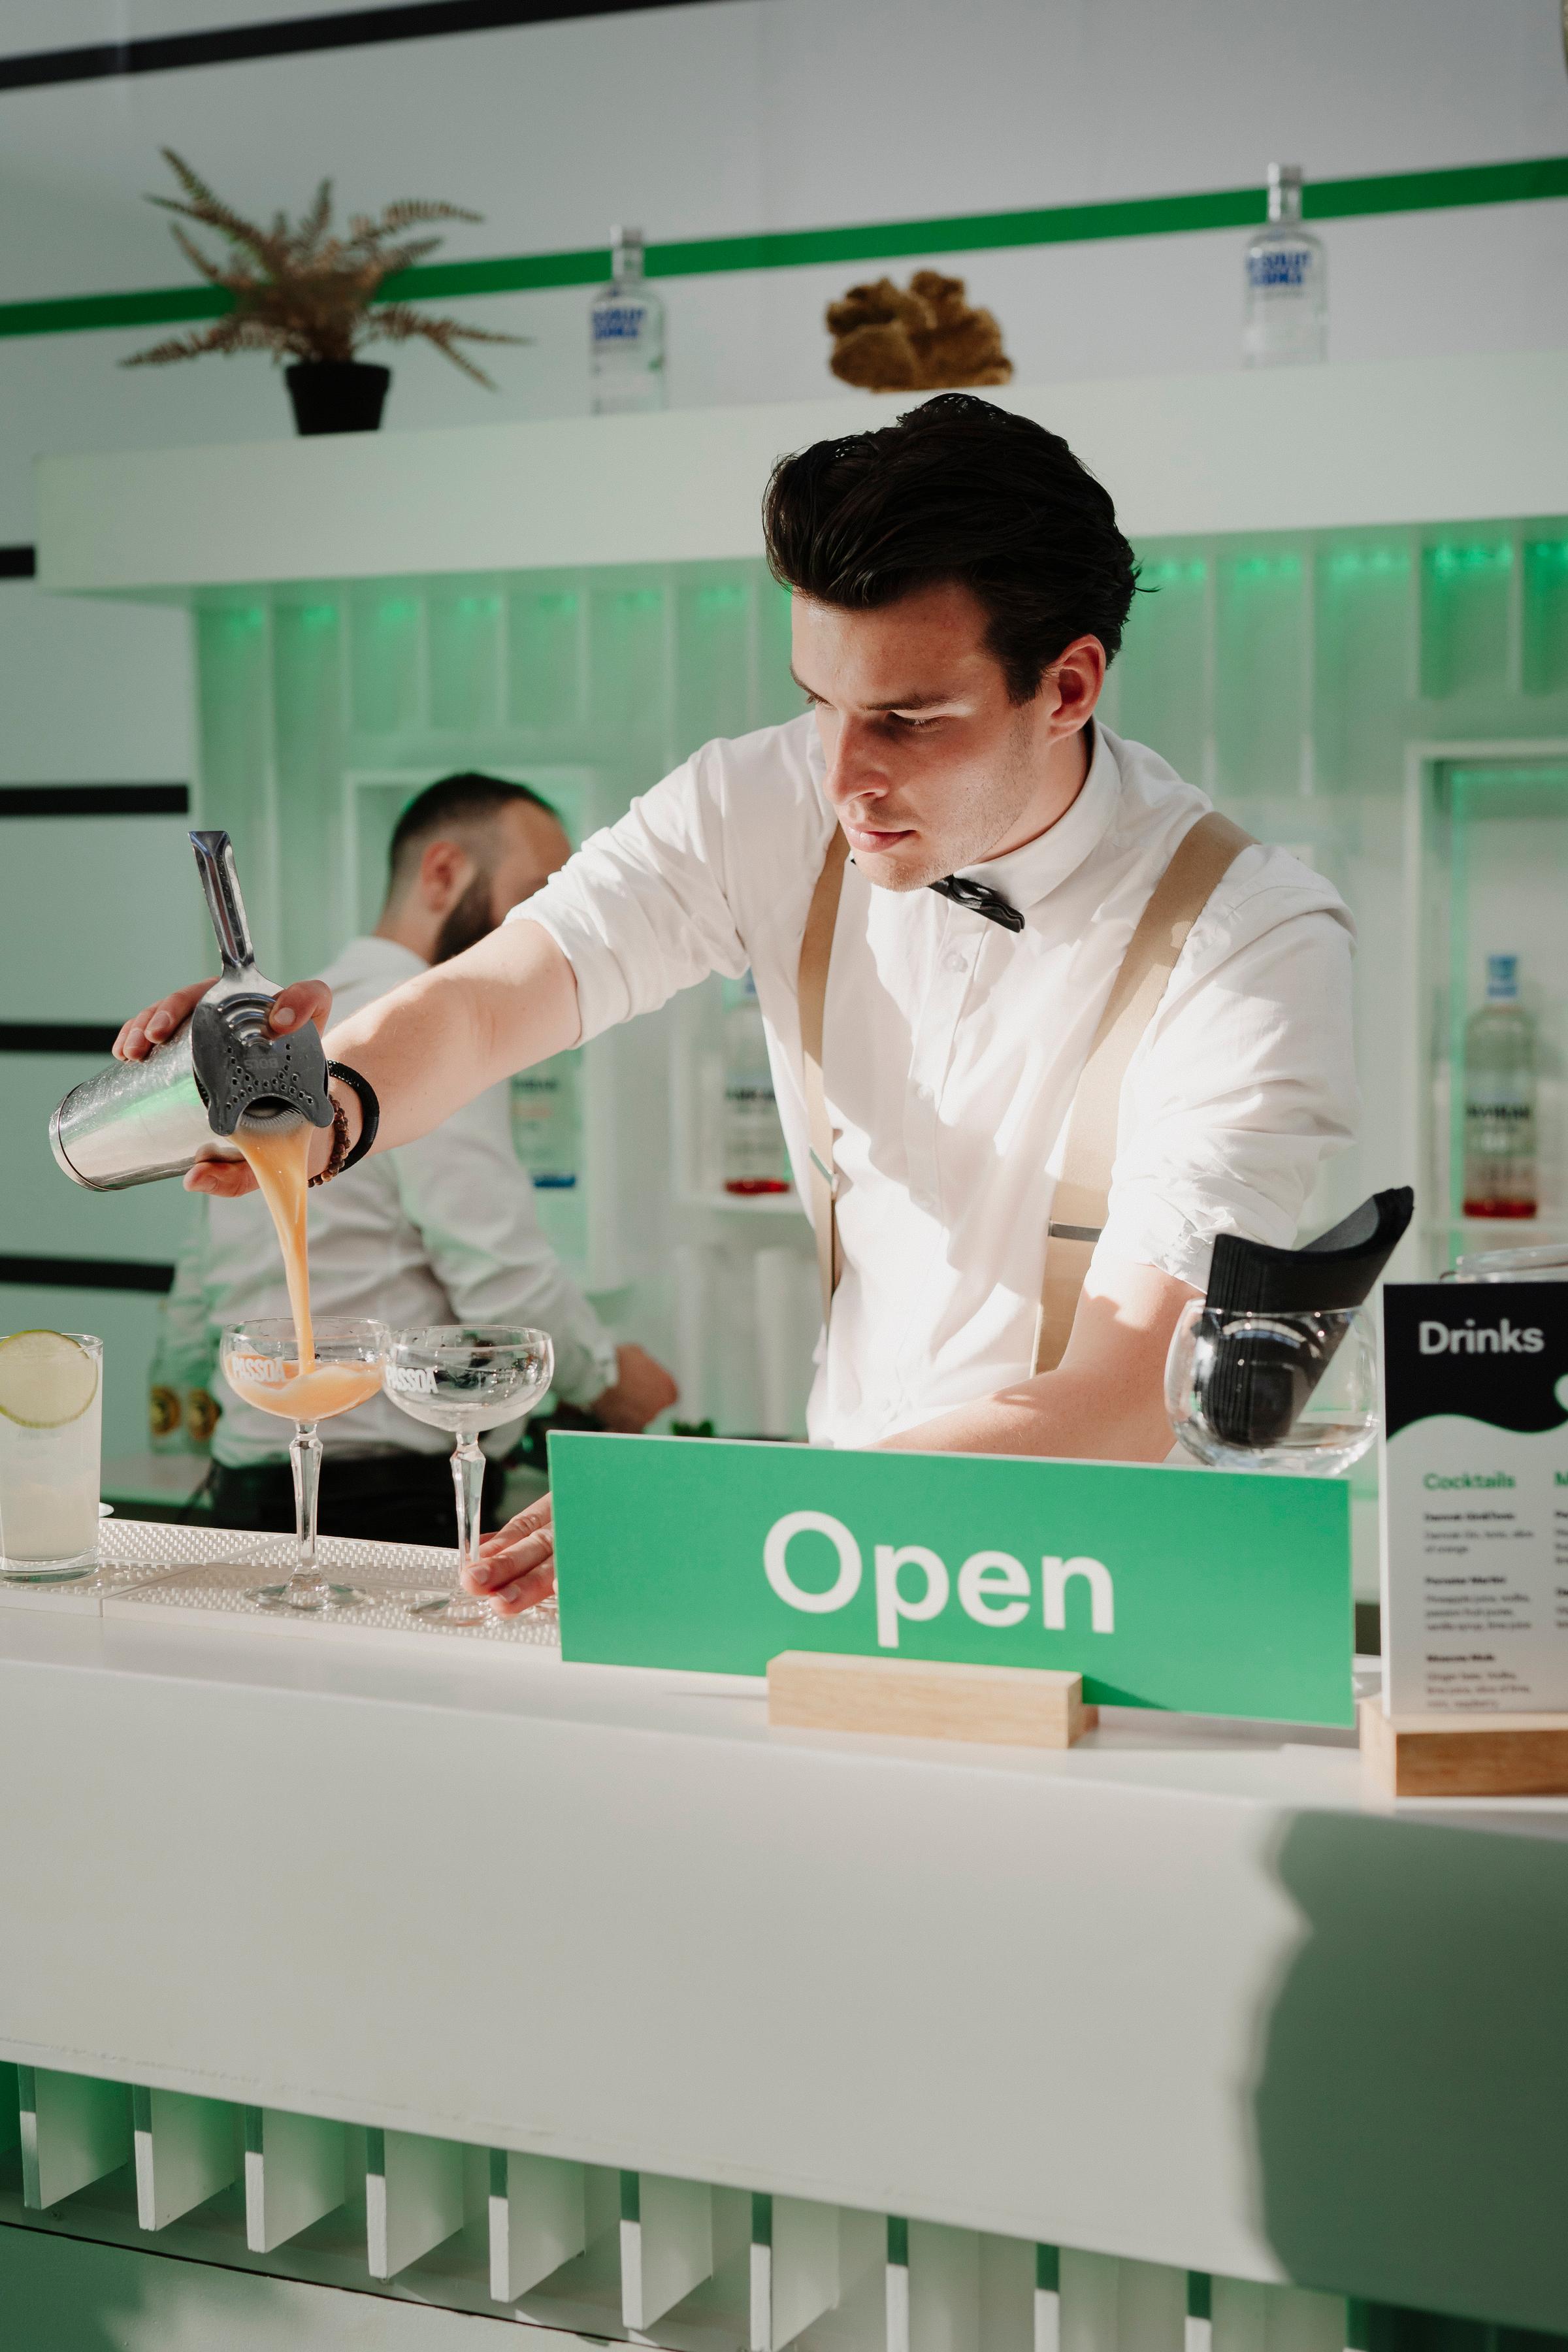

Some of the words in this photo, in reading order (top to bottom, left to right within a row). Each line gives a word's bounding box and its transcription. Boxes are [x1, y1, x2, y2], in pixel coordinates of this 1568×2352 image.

[244, 1058, 278, 1070] BOLS
[1419, 1318, 1544, 1355] Drinks
[1423, 1471, 1516, 1490] Cocktails
[763, 1510, 1115, 1649] Open
